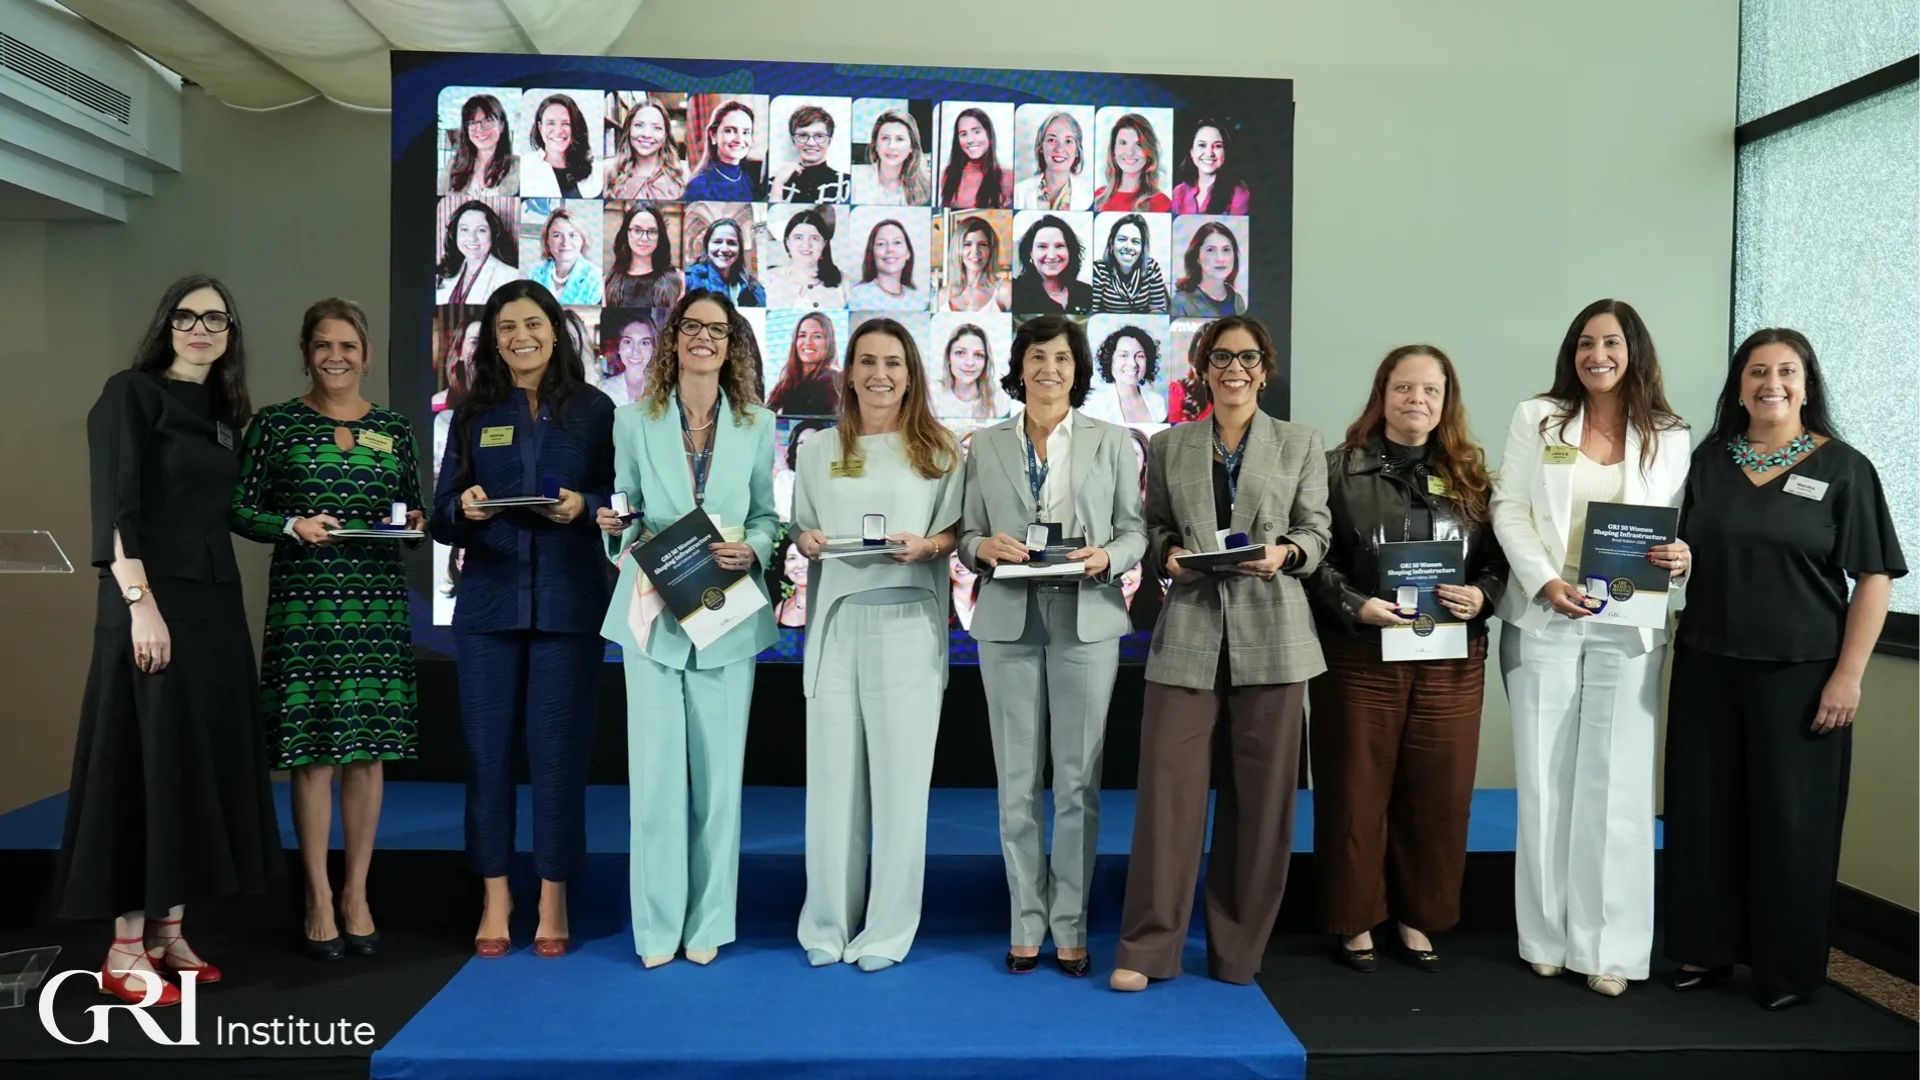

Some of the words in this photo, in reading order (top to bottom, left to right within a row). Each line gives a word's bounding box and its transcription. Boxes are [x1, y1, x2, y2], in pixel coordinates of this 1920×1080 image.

[1593, 528, 1619, 538] Shaping
[1619, 532, 1667, 541] Infrastructure
[654, 558, 676, 575] Shaping
[674, 534, 712, 561] Infrastructure
